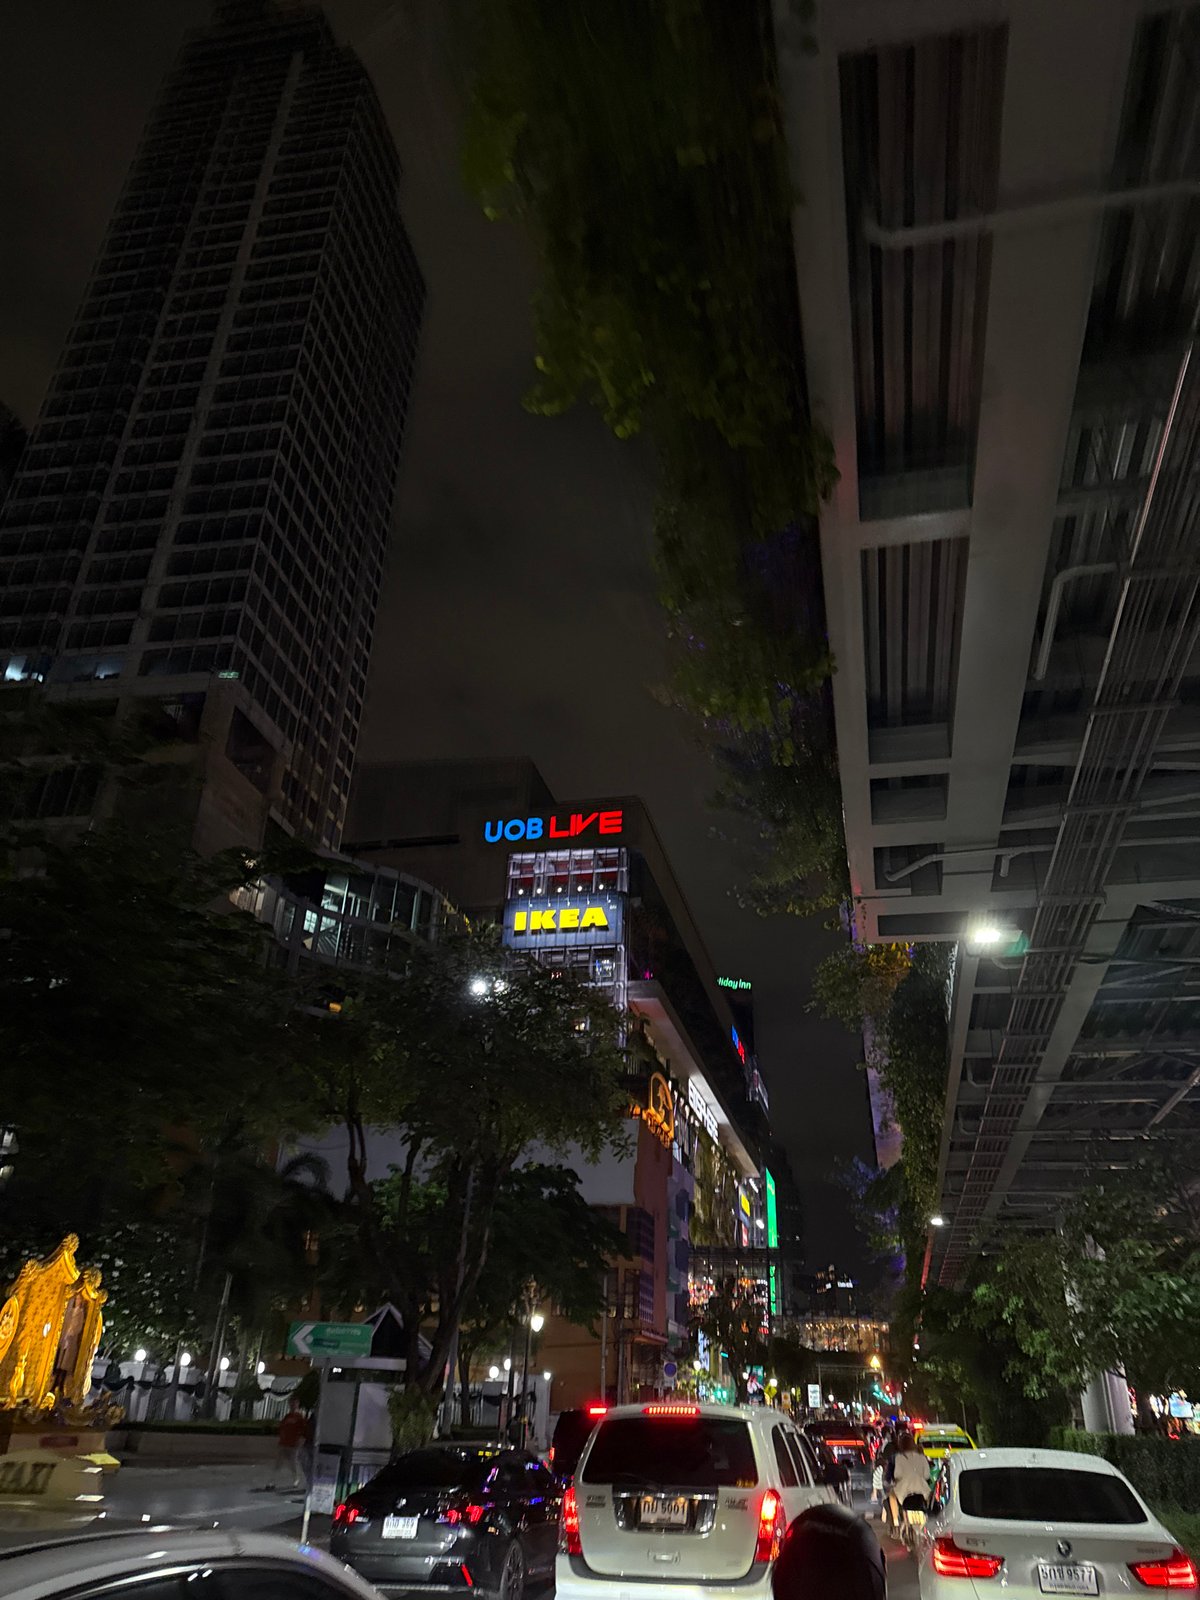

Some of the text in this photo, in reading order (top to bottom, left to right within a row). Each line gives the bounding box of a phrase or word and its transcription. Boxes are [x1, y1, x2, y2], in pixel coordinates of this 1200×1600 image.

[484, 809, 624, 844] UOB LIVE
[513, 907, 609, 932] IKEA
[738, 978, 752, 990] Inn
[1066, 1568, 1092, 1582] 9577
